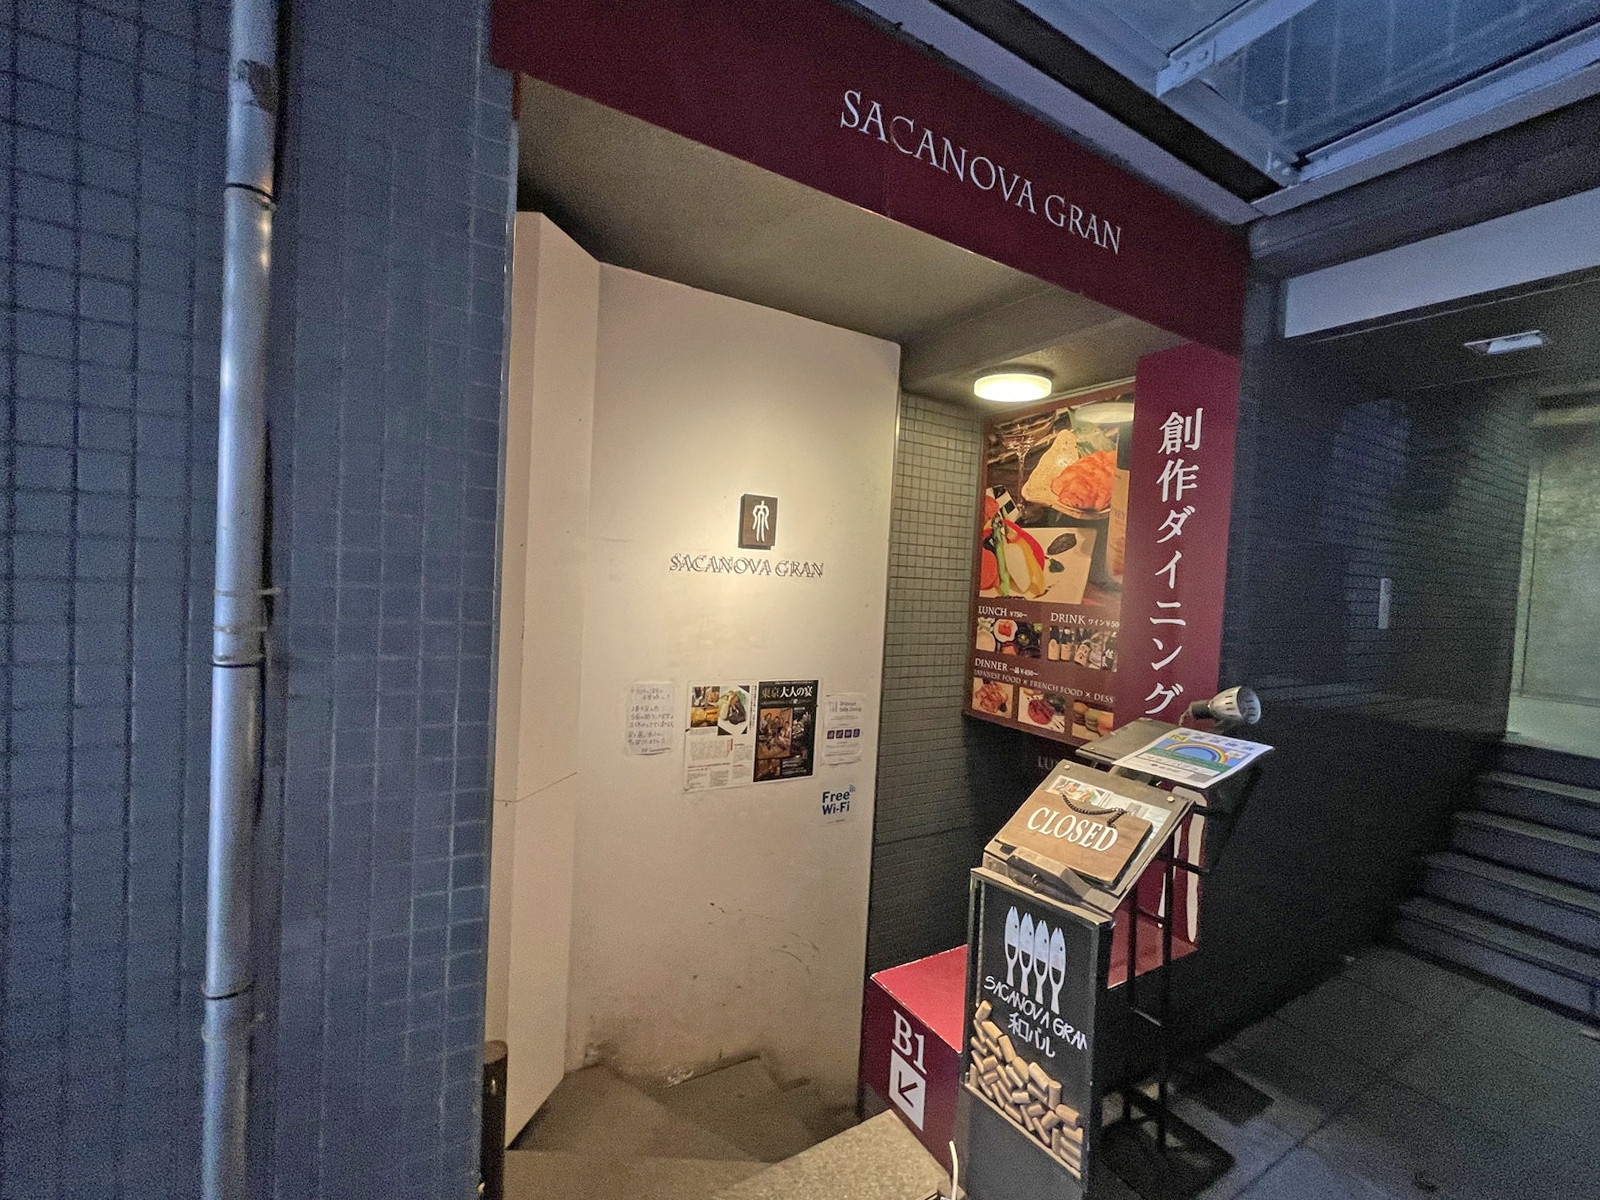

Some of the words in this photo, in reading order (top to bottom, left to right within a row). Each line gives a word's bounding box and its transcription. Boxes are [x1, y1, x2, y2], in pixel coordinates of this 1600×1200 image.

[840, 90, 1037, 215] SACANOVA
[1044, 194, 1121, 255] GRAN
[669, 553, 771, 576] SACANOVA
[775, 560, 825, 578] GRAN
[1145, 407, 1203, 715] 創作ダイニング
[978, 605, 1007, 617] LUNCH
[1050, 612, 1086, 625] DRINK
[974, 657, 1008, 672] DINNER
[1001, 674, 1022, 684] FOOD
[1030, 680, 1059, 692] FRENCH
[1060, 685, 1083, 697] FOOD
[822, 791, 850, 803] Free
[822, 801, 850, 815] Wi-Fi
[1026, 806, 1119, 852] CLOSED
[984, 975, 1050, 1029] SACANOVA
[892, 1010, 927, 1075] B1
[1008, 1012, 1055, 1058] 和バル
